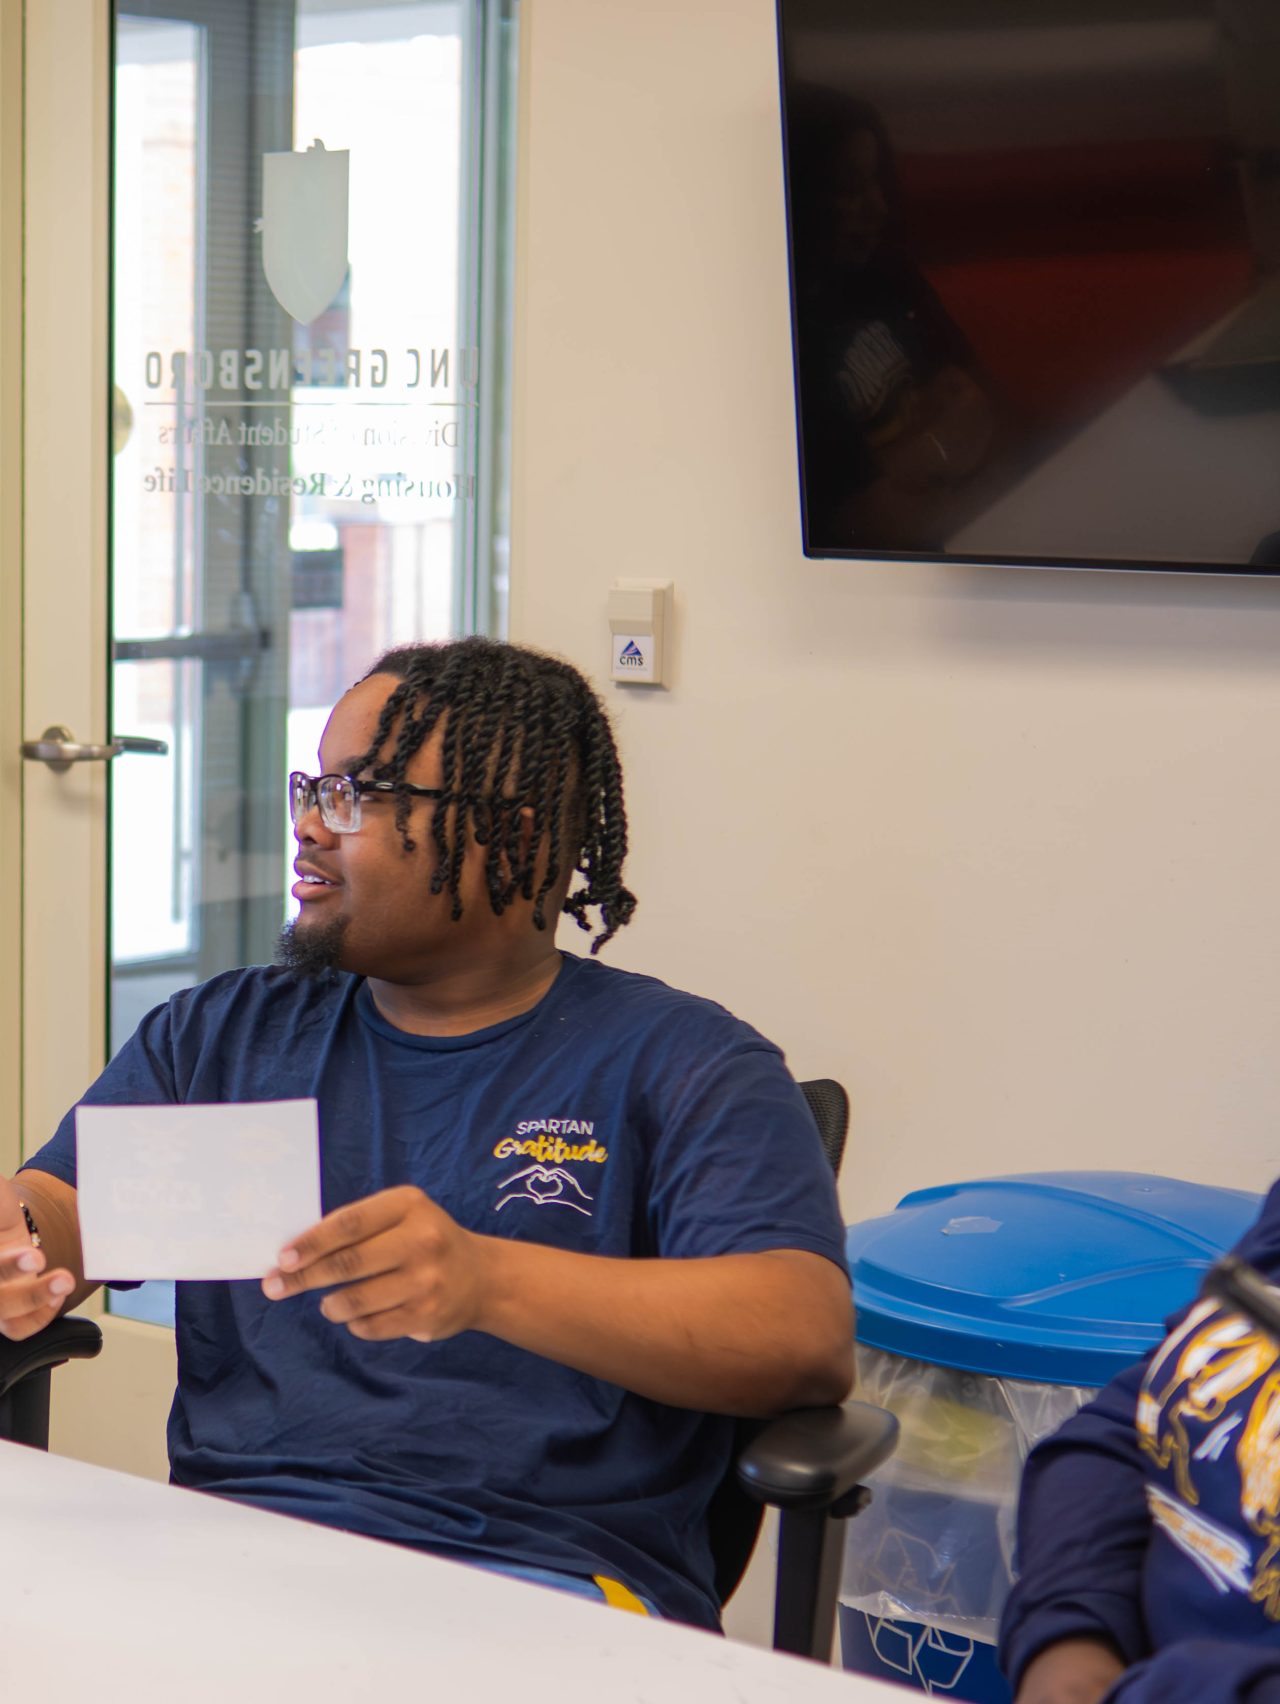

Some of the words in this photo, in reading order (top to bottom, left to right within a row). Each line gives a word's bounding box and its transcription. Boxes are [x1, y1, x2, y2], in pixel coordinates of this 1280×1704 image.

[620, 655, 644, 667] cms
[516, 1119, 594, 1135] SPARTAN
[493, 1135, 608, 1164] Gratitude
